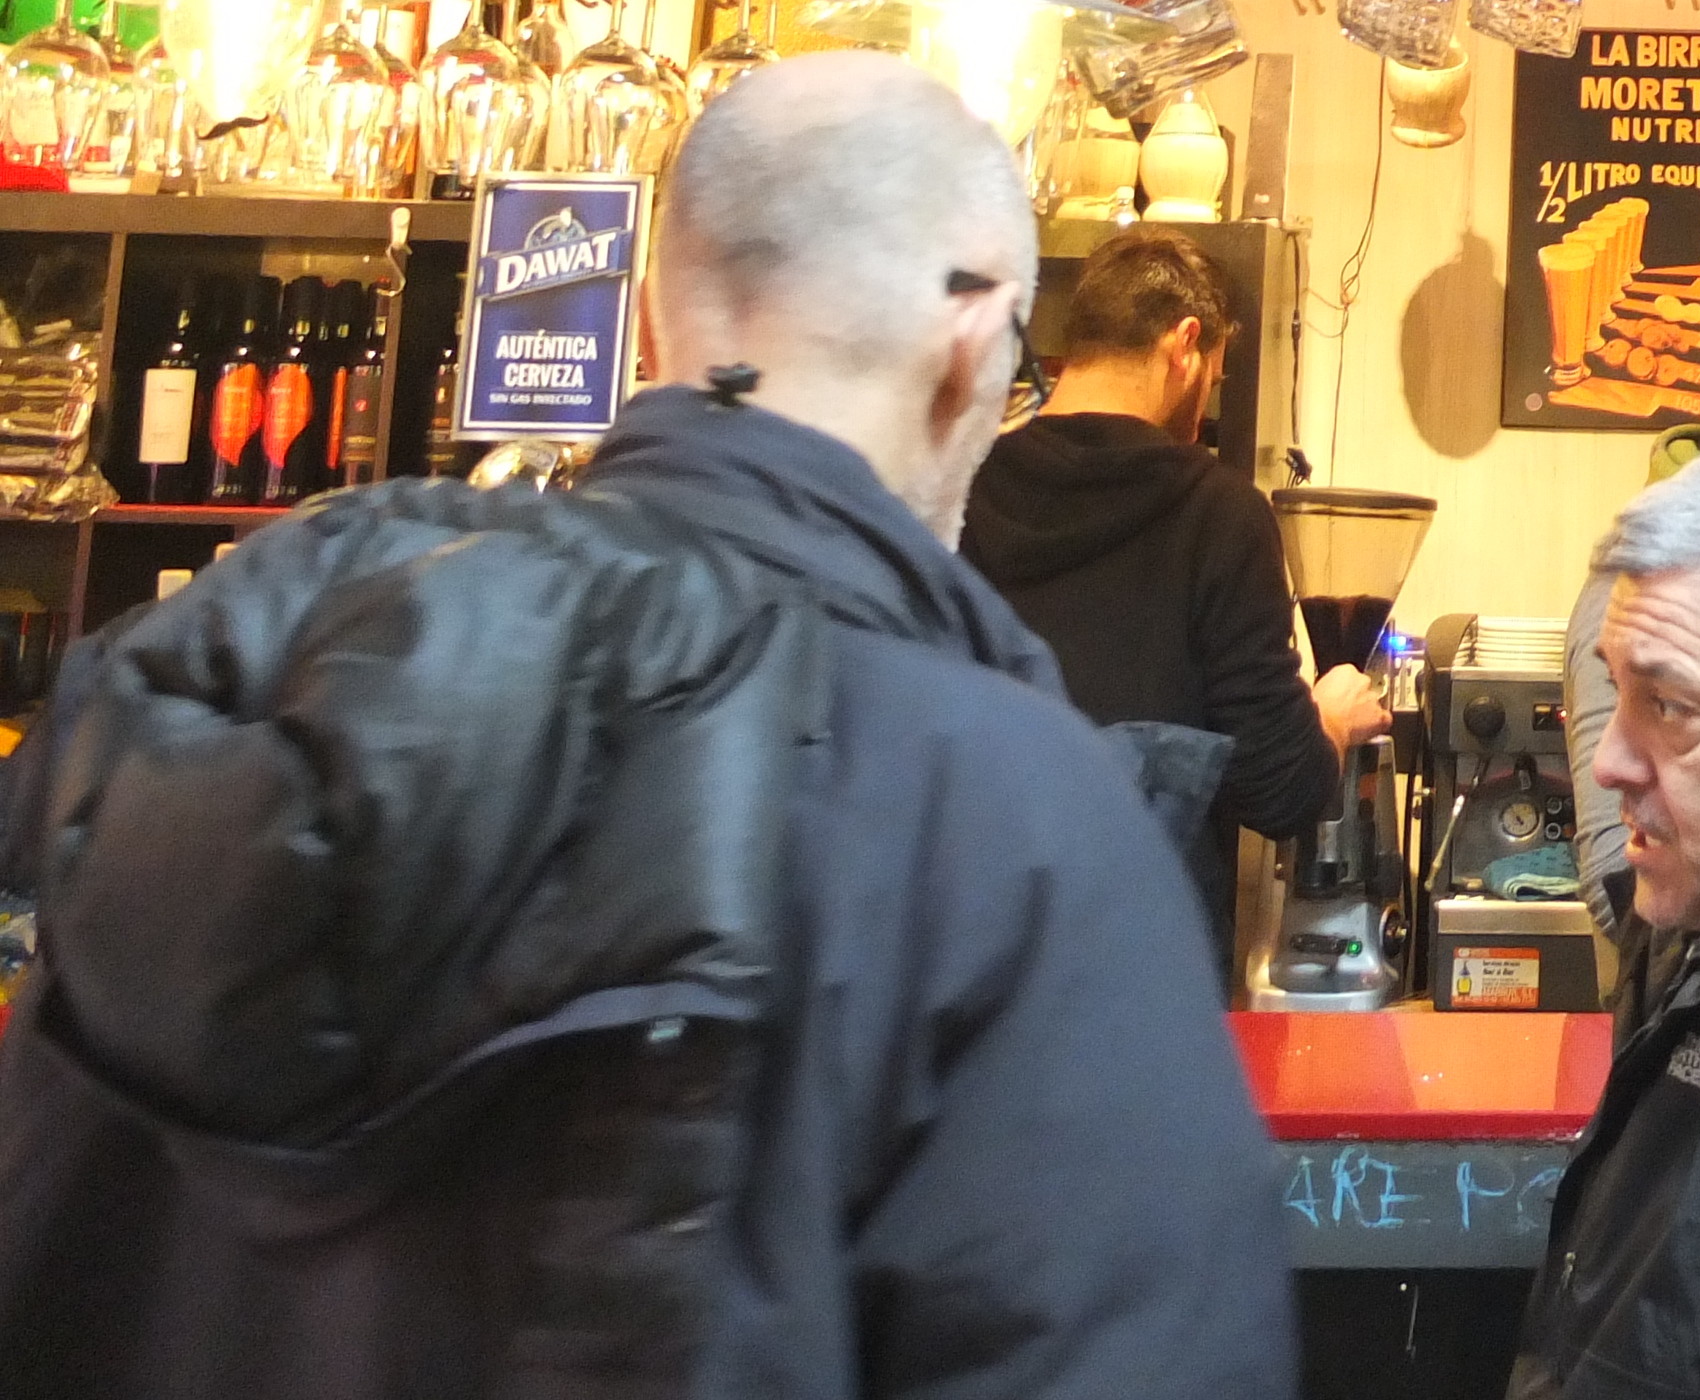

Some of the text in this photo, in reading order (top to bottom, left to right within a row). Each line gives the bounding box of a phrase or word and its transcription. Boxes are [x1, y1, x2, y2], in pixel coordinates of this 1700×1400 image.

[1591, 34, 1630, 67] LA
[1567, 161, 1642, 204] LITRO
[496, 232, 617, 293] DAWAT
[496, 329, 598, 360] AUTÉNTICA
[504, 363, 585, 388] CERVEZA
